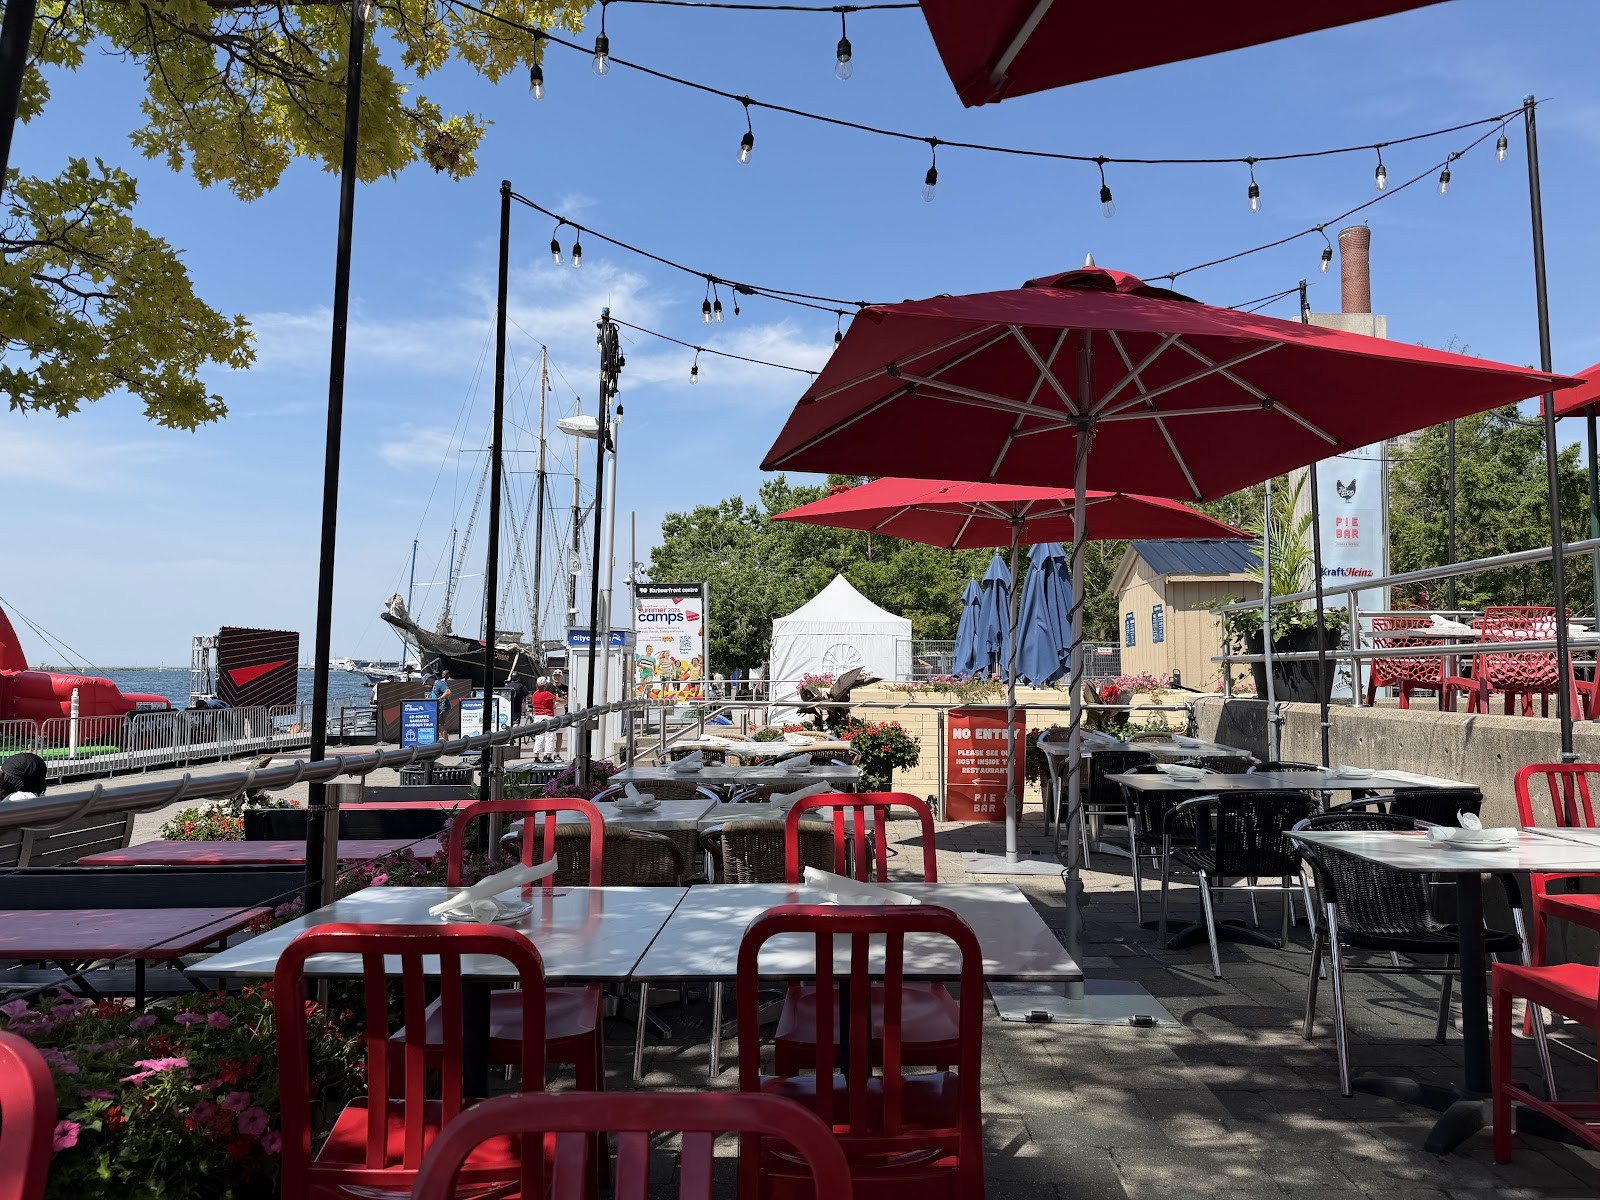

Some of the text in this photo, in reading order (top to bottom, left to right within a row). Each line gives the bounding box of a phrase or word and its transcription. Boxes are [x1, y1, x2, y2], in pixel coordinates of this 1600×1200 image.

[1336, 517, 1359, 527] PIE
[1336, 529, 1359, 539] BAR
[638, 613, 684, 624] camps
[953, 728, 1020, 740] NO ENTRY
[957, 749, 984, 757] PLEASE
[974, 793, 997, 803] PIE
[974, 804, 996, 813] BAR
